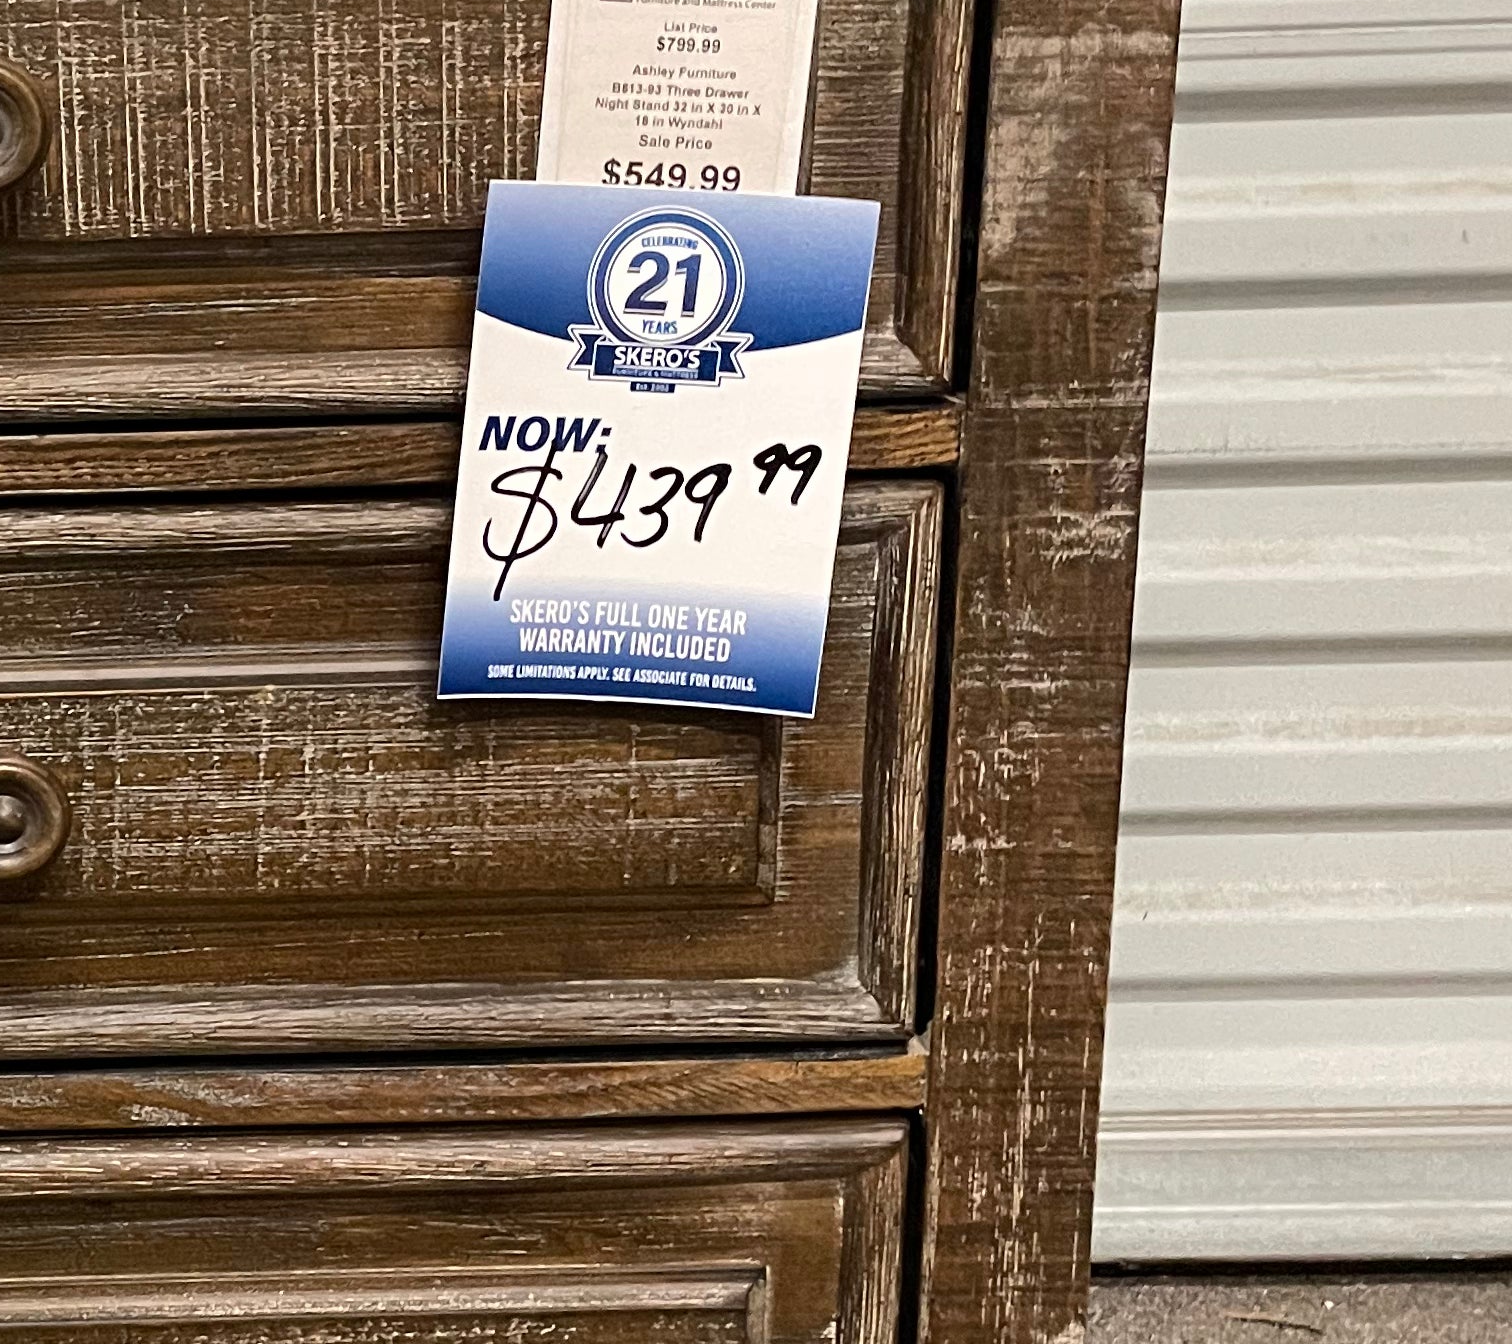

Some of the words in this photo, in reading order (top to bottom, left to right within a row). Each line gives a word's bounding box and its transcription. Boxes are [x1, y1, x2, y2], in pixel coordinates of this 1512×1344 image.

[745, 1, 776, 9] Center
[664, 22, 686, 33] List
[689, 23, 717, 34] Price
[656, 37, 721, 54] $799.99
[633, 65, 674, 79] Ashley
[679, 67, 737, 79] Furniture
[667, 85, 701, 97] Three
[706, 87, 749, 99] Drawer
[595, 97, 629, 111] Night
[633, 100, 669, 111] Stand
[673, 102, 687, 112] 32
[653, 116, 664, 127] in
[669, 118, 722, 130] Wyndahl
[639, 135, 670, 148] Sale
[676, 136, 712, 149] Price
[602, 158, 741, 191] $549.99
[642, 236, 699, 250] CELEBRATING
[623, 251, 702, 318] 21
[642, 320, 677, 334] YEARS
[613, 347, 700, 368] SKERO'S
[479, 415, 612, 452] NOW:
[510, 599, 590, 624] SKERO'S
[595, 602, 641, 628] FULL
[648, 605, 689, 630] ONE
[695, 608, 747, 635] YEAR
[519, 628, 625, 654] WARRANTY
[629, 631, 731, 662] INCLUDED
[487, 665, 514, 679] SOME
[516, 665, 576, 679] LIMITATIONS
[577, 666, 610, 680] APPLY.
[612, 669, 630, 682] SEE
[633, 671, 687, 686] ASSOCIATE
[689, 674, 710, 687] FOR
[712, 676, 757, 692] DETAILS.
